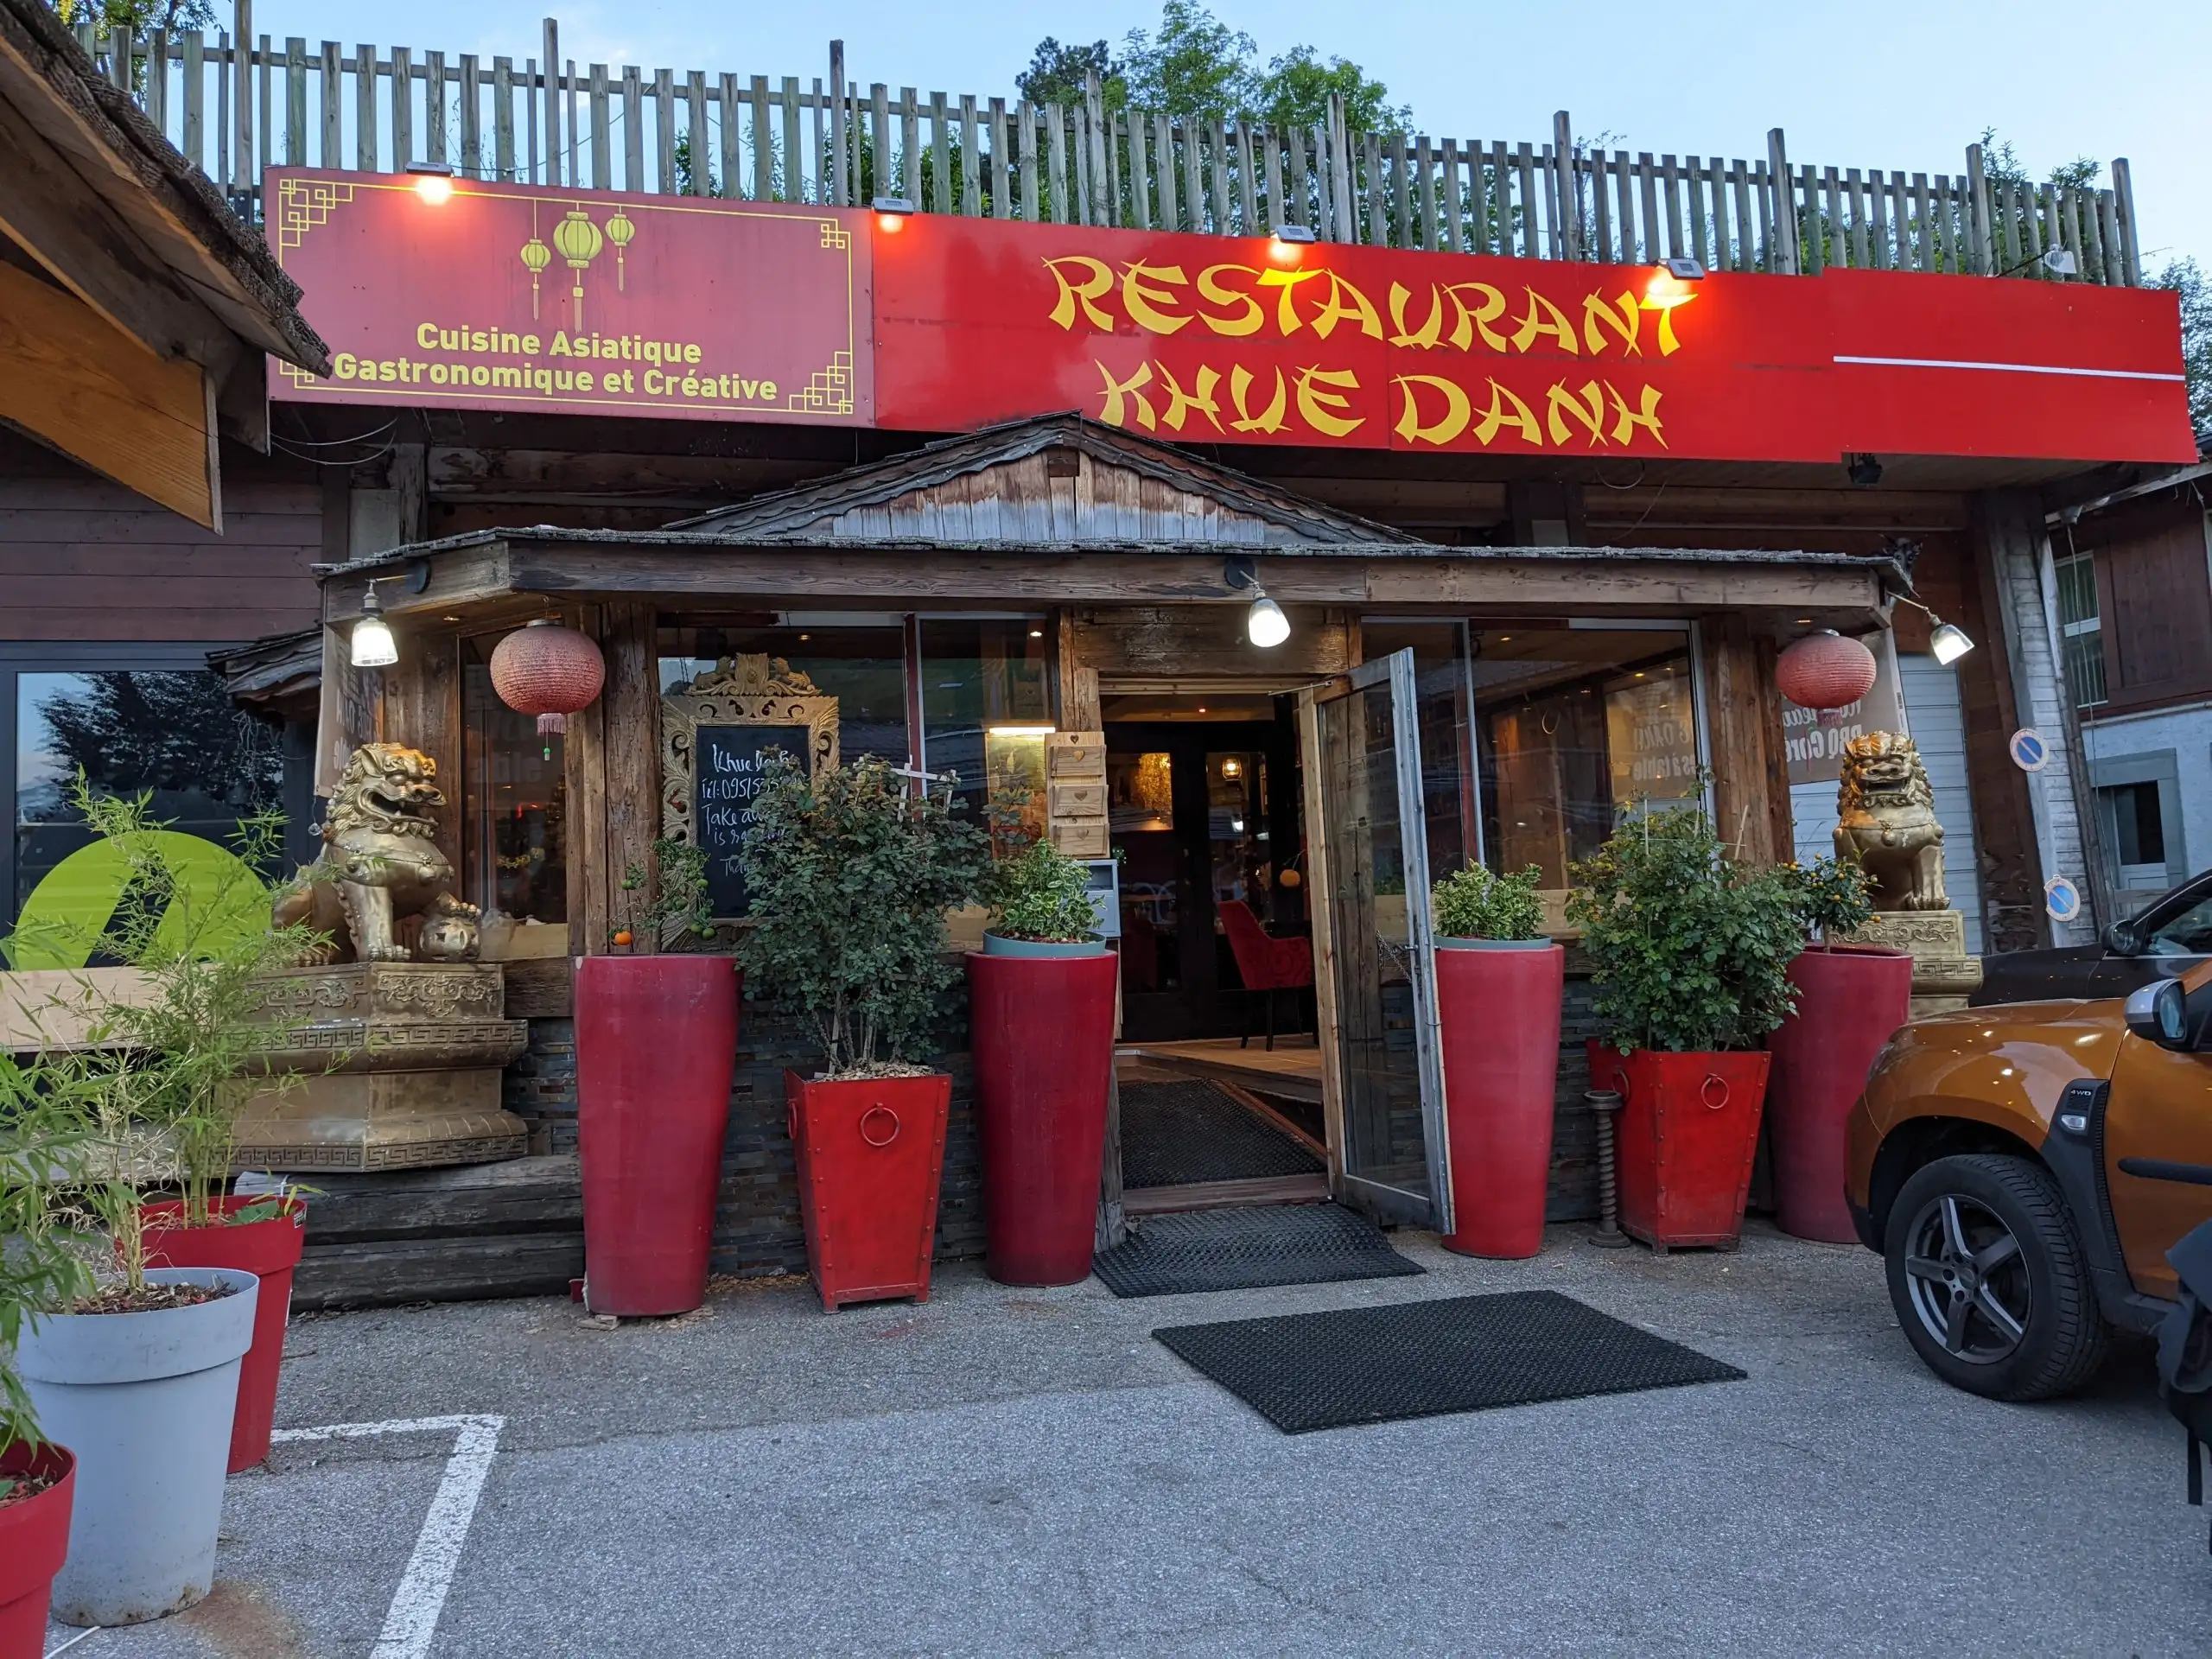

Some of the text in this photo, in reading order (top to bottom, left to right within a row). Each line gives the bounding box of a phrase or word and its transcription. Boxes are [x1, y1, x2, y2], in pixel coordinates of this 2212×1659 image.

[1040, 255, 1698, 356] RESTAURANT
[416, 322, 702, 367] Cuisine Asiatique
[334, 353, 778, 400] Gastronomique et Créative
[1095, 359, 1669, 448] KHUE DANH
[713, 744, 753, 772] Khue
[702, 804, 738, 836] Take
[715, 828, 726, 846] is
